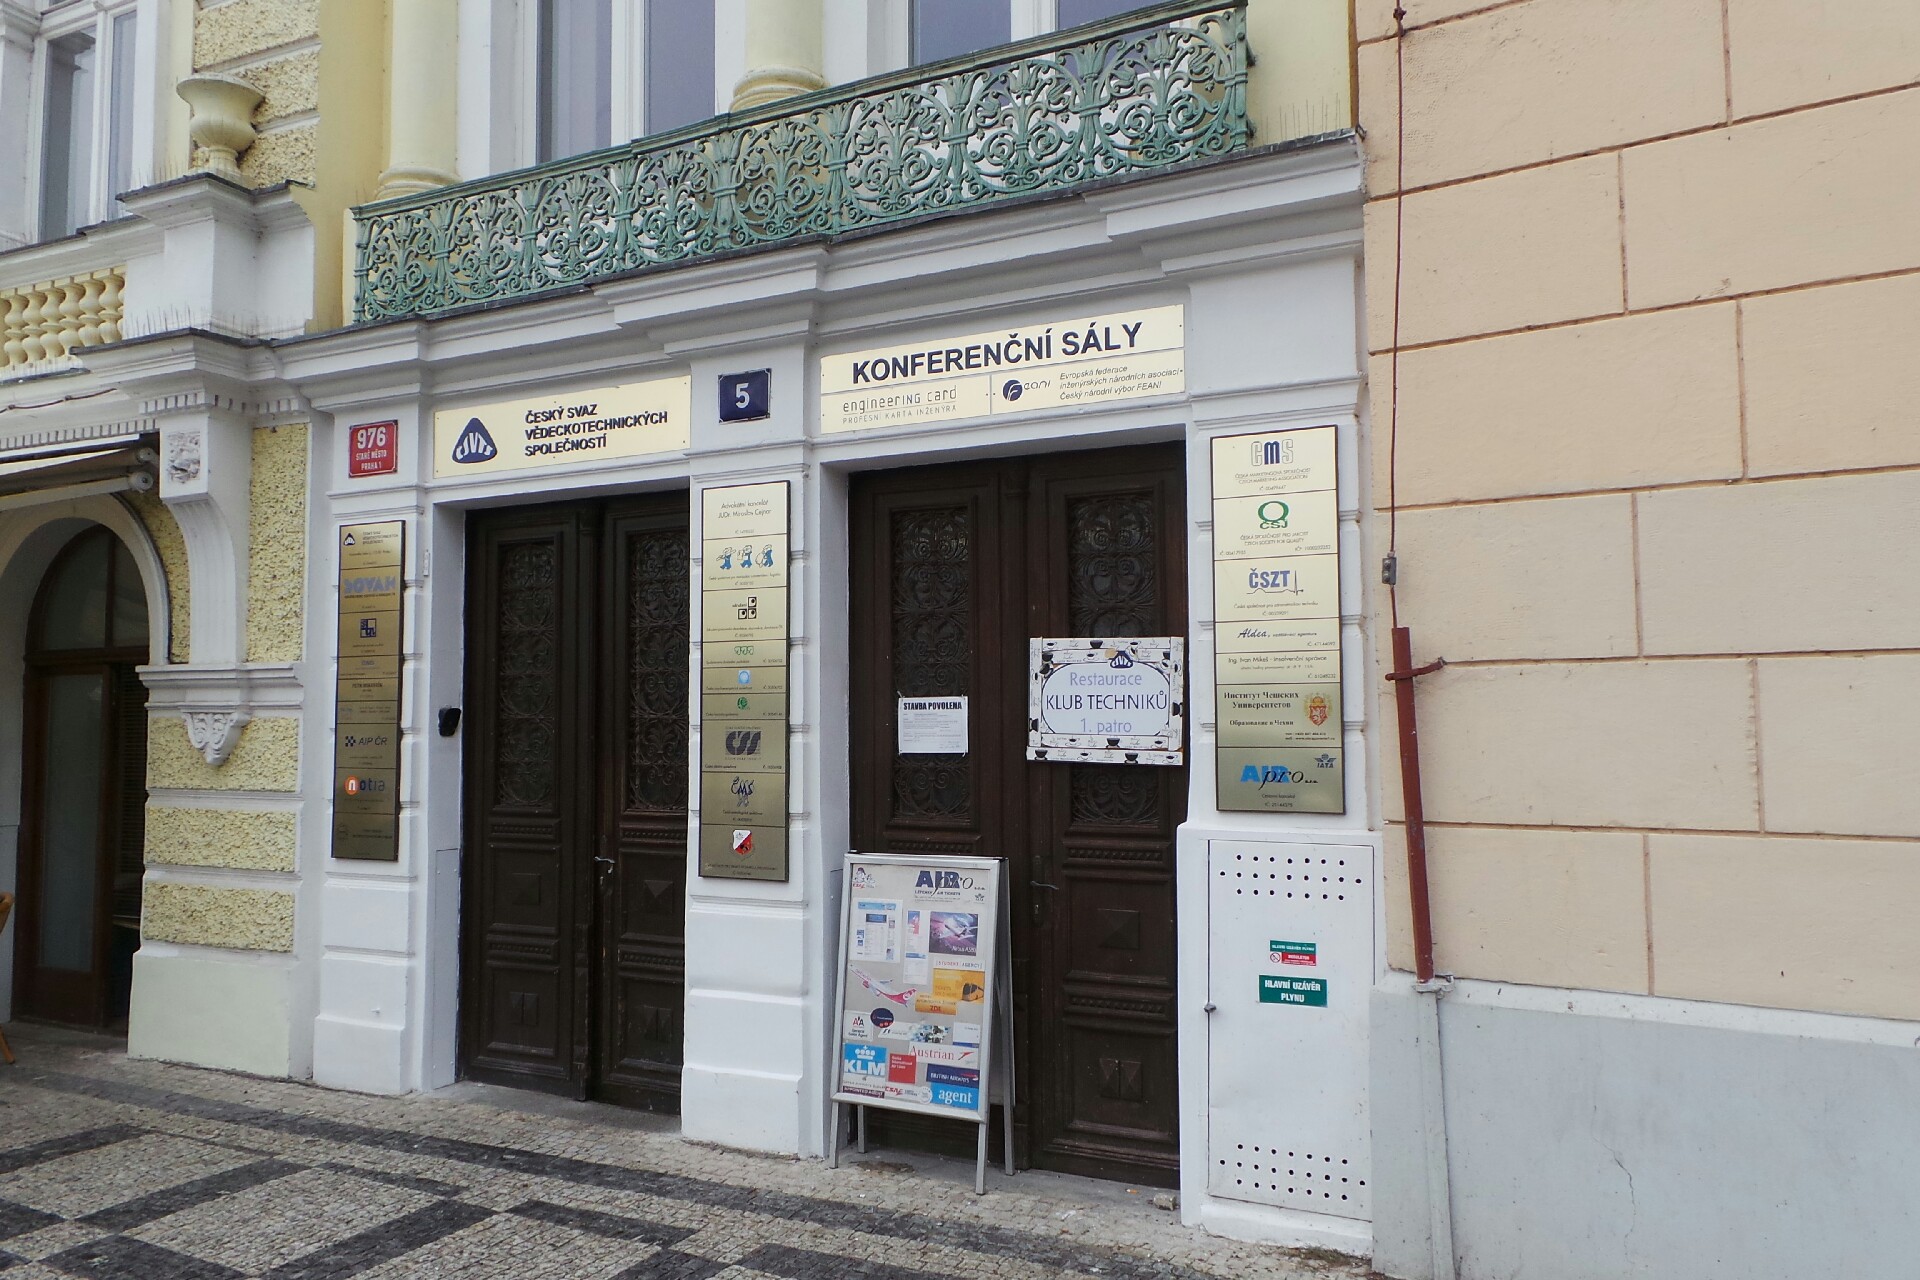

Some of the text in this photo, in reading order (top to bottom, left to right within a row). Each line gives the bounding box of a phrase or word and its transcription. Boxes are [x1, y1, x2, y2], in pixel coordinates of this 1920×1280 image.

[853, 322, 1142, 384] KONFERENČNÍ SÁLY
[1060, 366, 1128, 381] Evropská federace
[1060, 377, 1107, 391] inženýrských
[1109, 372, 1146, 384] národních
[735, 382, 750, 409] 5
[928, 385, 957, 400] card
[1084, 387, 1112, 398] národní
[1114, 384, 1135, 397] výbor
[525, 404, 598, 424] ČESKÝ SVAZ
[885, 411, 912, 419] KARTA
[917, 404, 957, 415] INŽENÝRA
[525, 411, 667, 440] VĚDECKOTECHNICKÝCH
[357, 426, 386, 449] 976
[524, 433, 607, 457] SPOLEČNOSTÍ
[356, 449, 387, 460] STARÉ MĚSTO
[361, 461, 377, 470] PRAHA
[1249, 568, 1290, 588] ČSZT
[1070, 672, 1142, 686] Restaurace
[1046, 690, 1167, 710] KLUB TECHNIKŮ
[1224, 691, 1299, 700] Институт Чешских
[903, 701, 962, 710] STAVBA POVOLENA
[1233, 701, 1291, 709] Университетов
[1081, 718, 1132, 735] 1. patro
[359, 736, 388, 745] AIP ČR
[348, 777, 385, 791] notia
[1265, 979, 1321, 991] HLAVNÍ UZÁVĚR
[1281, 993, 1305, 1002] PLYNU
[910, 1045, 954, 1060] Austrian
[844, 1058, 886, 1076] KLM
[930, 1072, 949, 1080] BRITISH
[938, 1089, 973, 1104] agent
